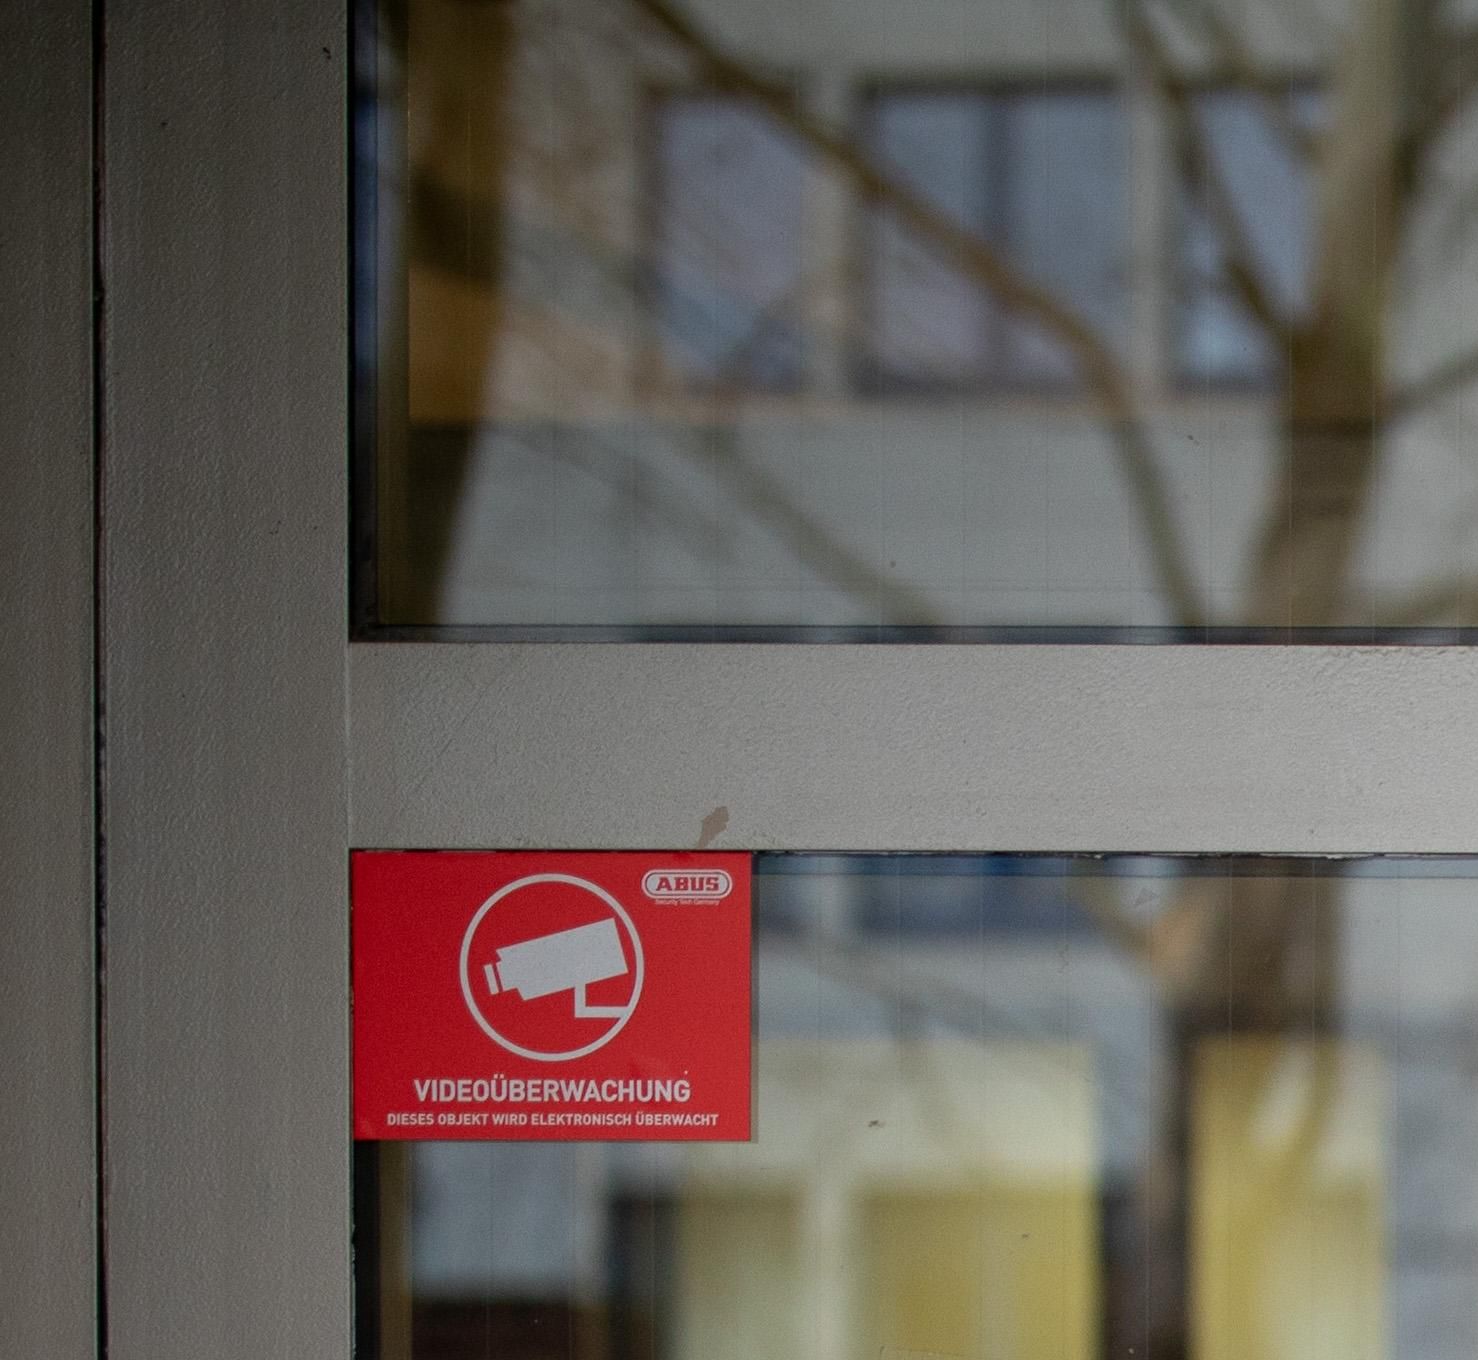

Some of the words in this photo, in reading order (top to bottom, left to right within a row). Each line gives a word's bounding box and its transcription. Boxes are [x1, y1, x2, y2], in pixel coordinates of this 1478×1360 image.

[655, 877, 719, 891] ABUS
[413, 1074, 691, 1103] VIDEOÜBERWACHUNG
[387, 1113, 434, 1126] DIESES
[438, 1113, 489, 1126] OBJEKT
[492, 1113, 528, 1126] WIRD
[531, 1113, 632, 1127] ELEKTRONISCH
[635, 1110, 719, 1127] ÜBERWACHT
